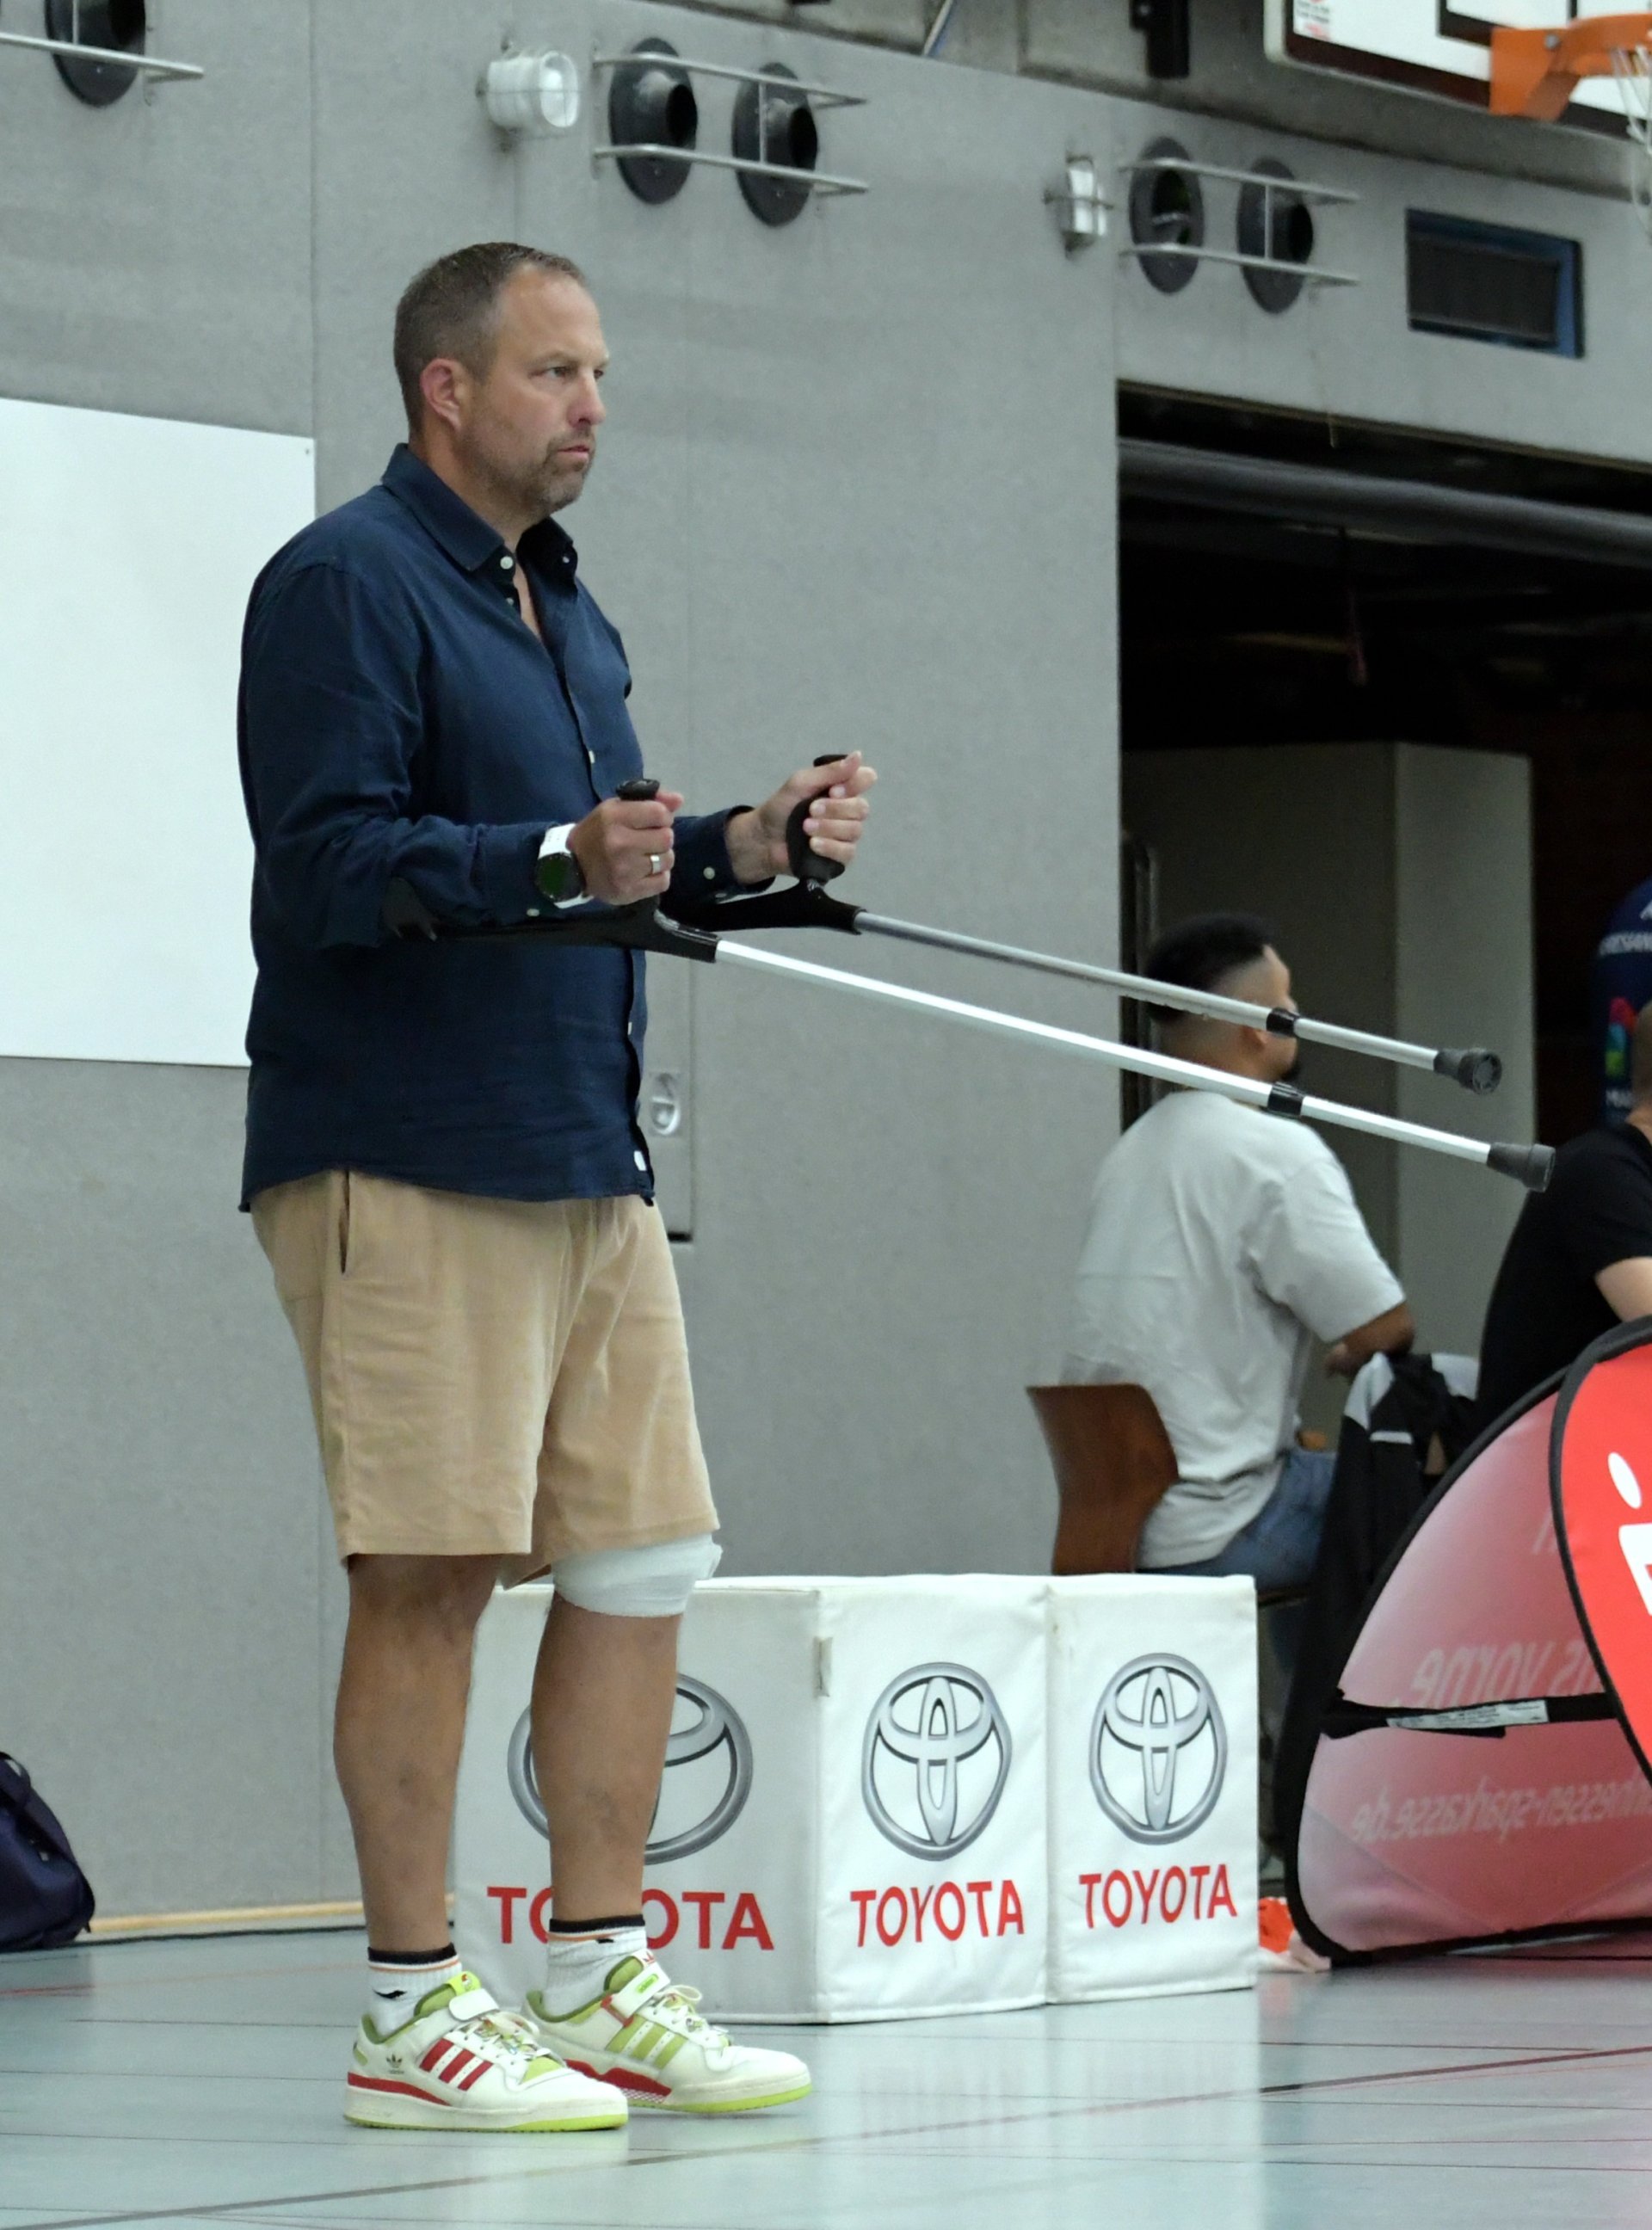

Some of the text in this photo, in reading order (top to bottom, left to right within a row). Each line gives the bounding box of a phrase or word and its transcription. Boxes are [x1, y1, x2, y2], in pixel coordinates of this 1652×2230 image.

[487, 1886, 774, 1950] TOTA
[850, 1879, 1024, 1947] TOYOTA
[1079, 1863, 1237, 1929] TOYOTA
